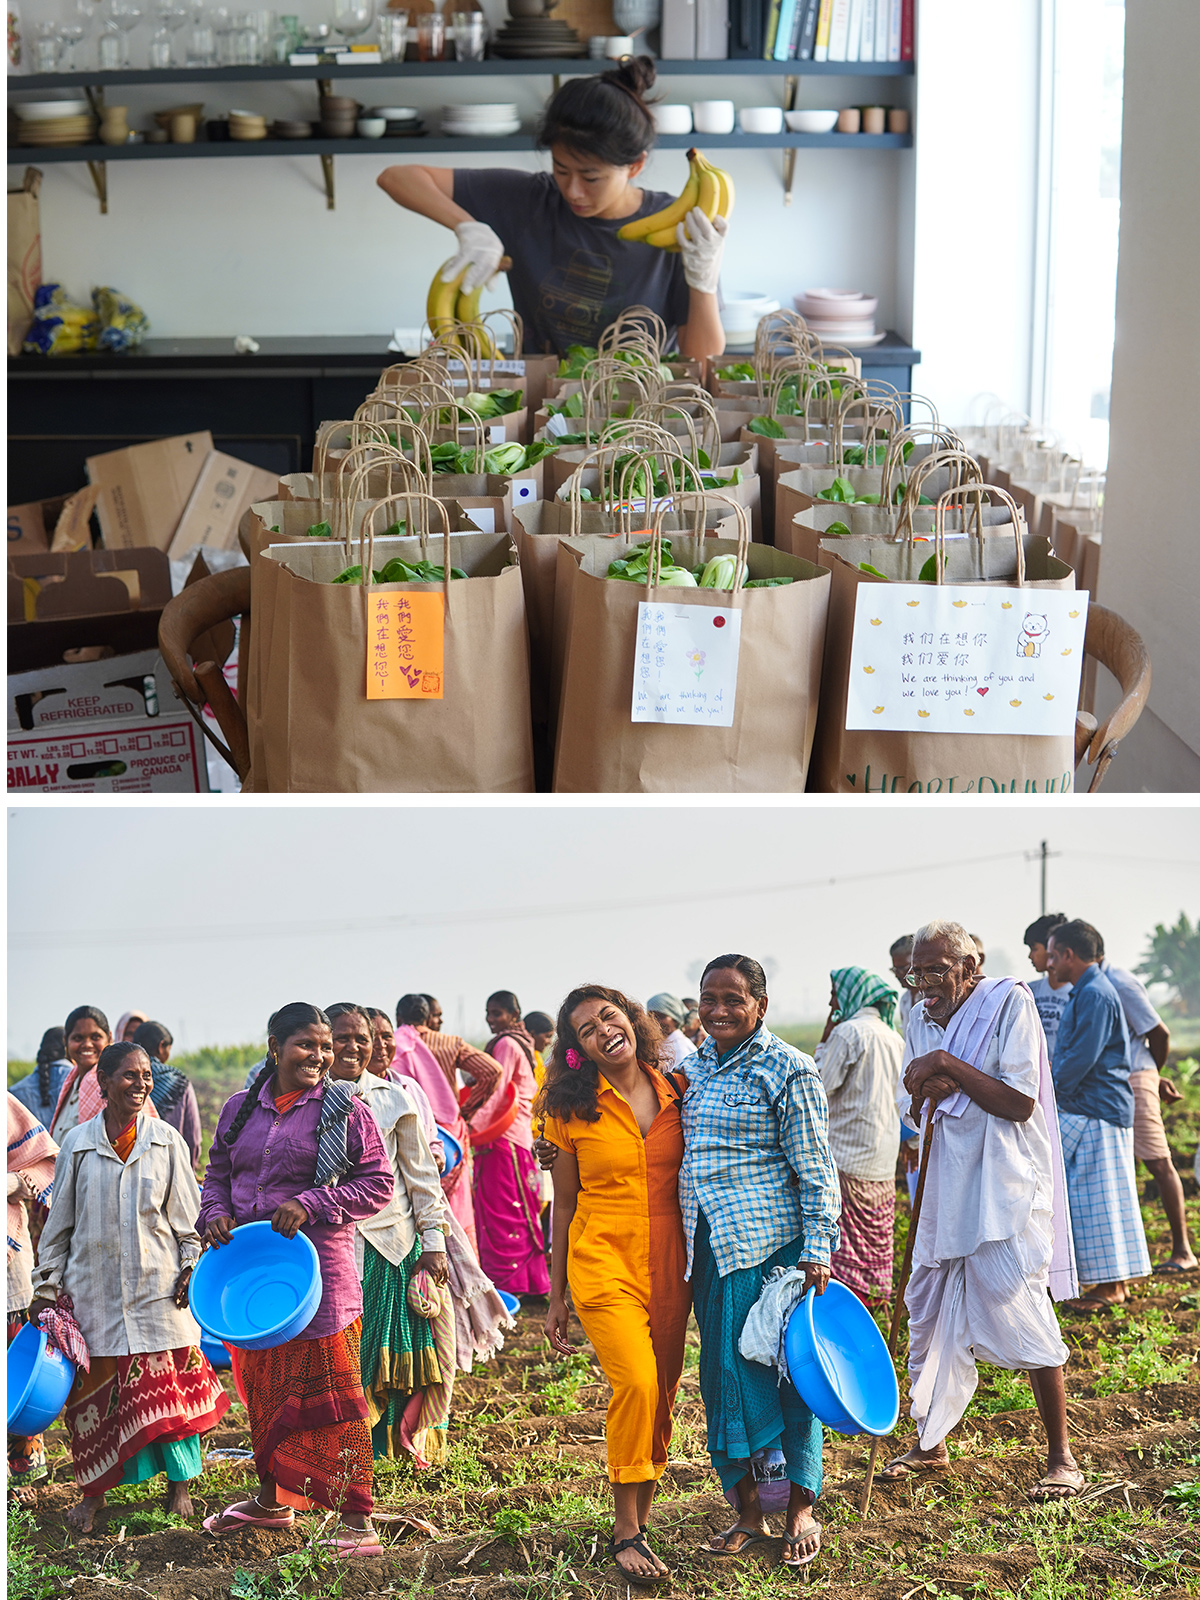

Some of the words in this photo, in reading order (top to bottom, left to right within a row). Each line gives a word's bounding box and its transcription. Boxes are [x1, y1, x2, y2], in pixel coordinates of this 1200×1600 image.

[902, 631, 988, 647] 我们在想你
[901, 651, 969, 666] 我们爱你
[901, 672, 917, 683] We
[922, 674, 938, 683] are
[941, 673, 978, 689] thinking
[983, 671, 995, 682] of
[998, 674, 1014, 686] you
[1018, 673, 1035, 682] and
[902, 689, 916, 698] we
[922, 687, 939, 697] love
[67, 695, 101, 708] KEEP
[654, 704, 668, 712] and
[40, 702, 134, 721] REFRIGERATED
[20, 749, 38, 760] WT.
[130, 755, 177, 768] PRODUCE
[178, 753, 191, 762] OF
[7, 763, 59, 788] BALLY
[142, 764, 182, 777] CANADA
